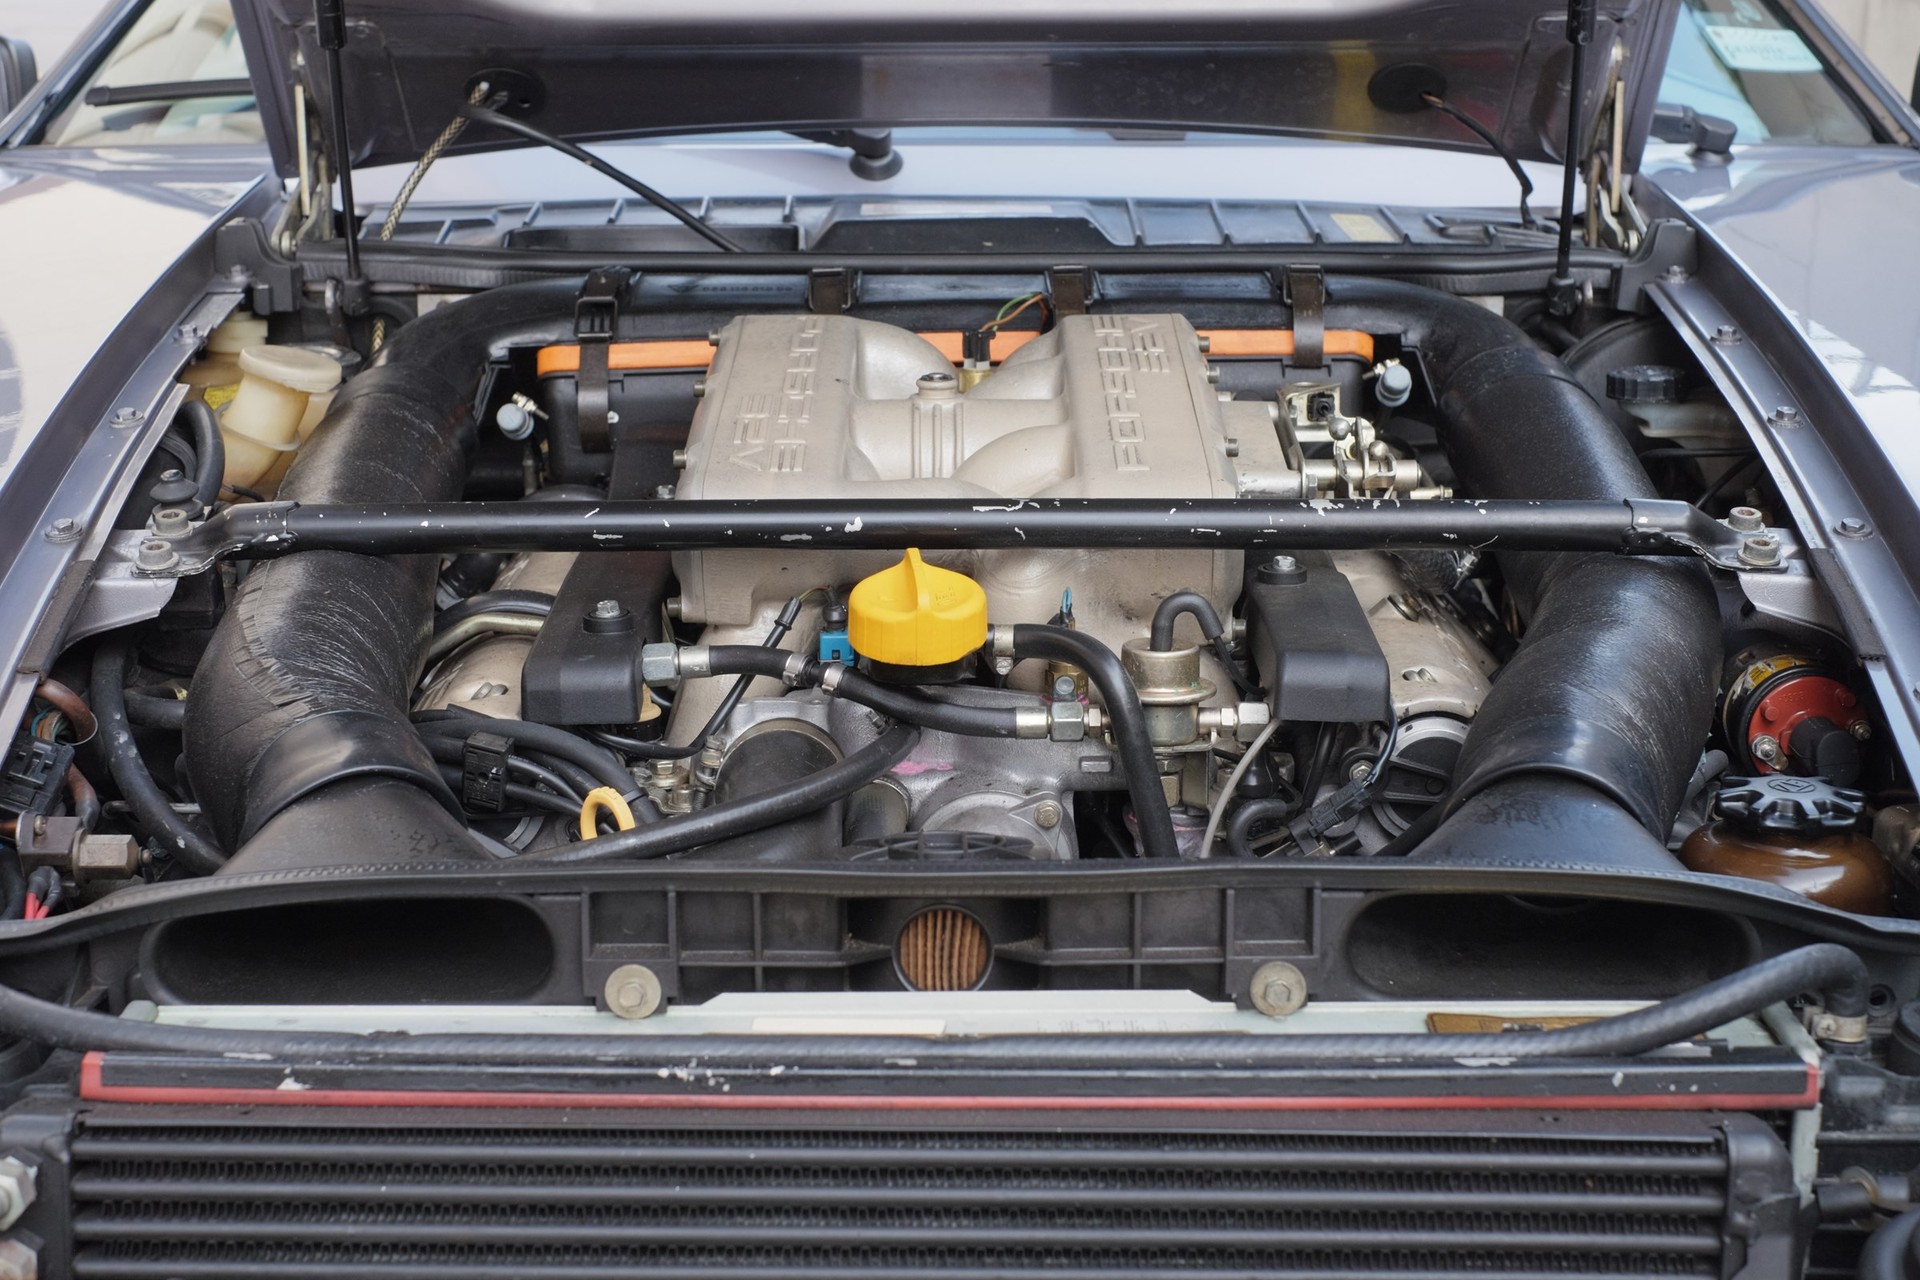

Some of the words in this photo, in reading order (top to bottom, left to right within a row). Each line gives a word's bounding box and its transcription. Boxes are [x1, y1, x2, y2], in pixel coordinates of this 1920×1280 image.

[729, 394, 771, 472] 32V
[769, 316, 824, 472] PORSCHE
[1090, 316, 1150, 471] PORSCHE
